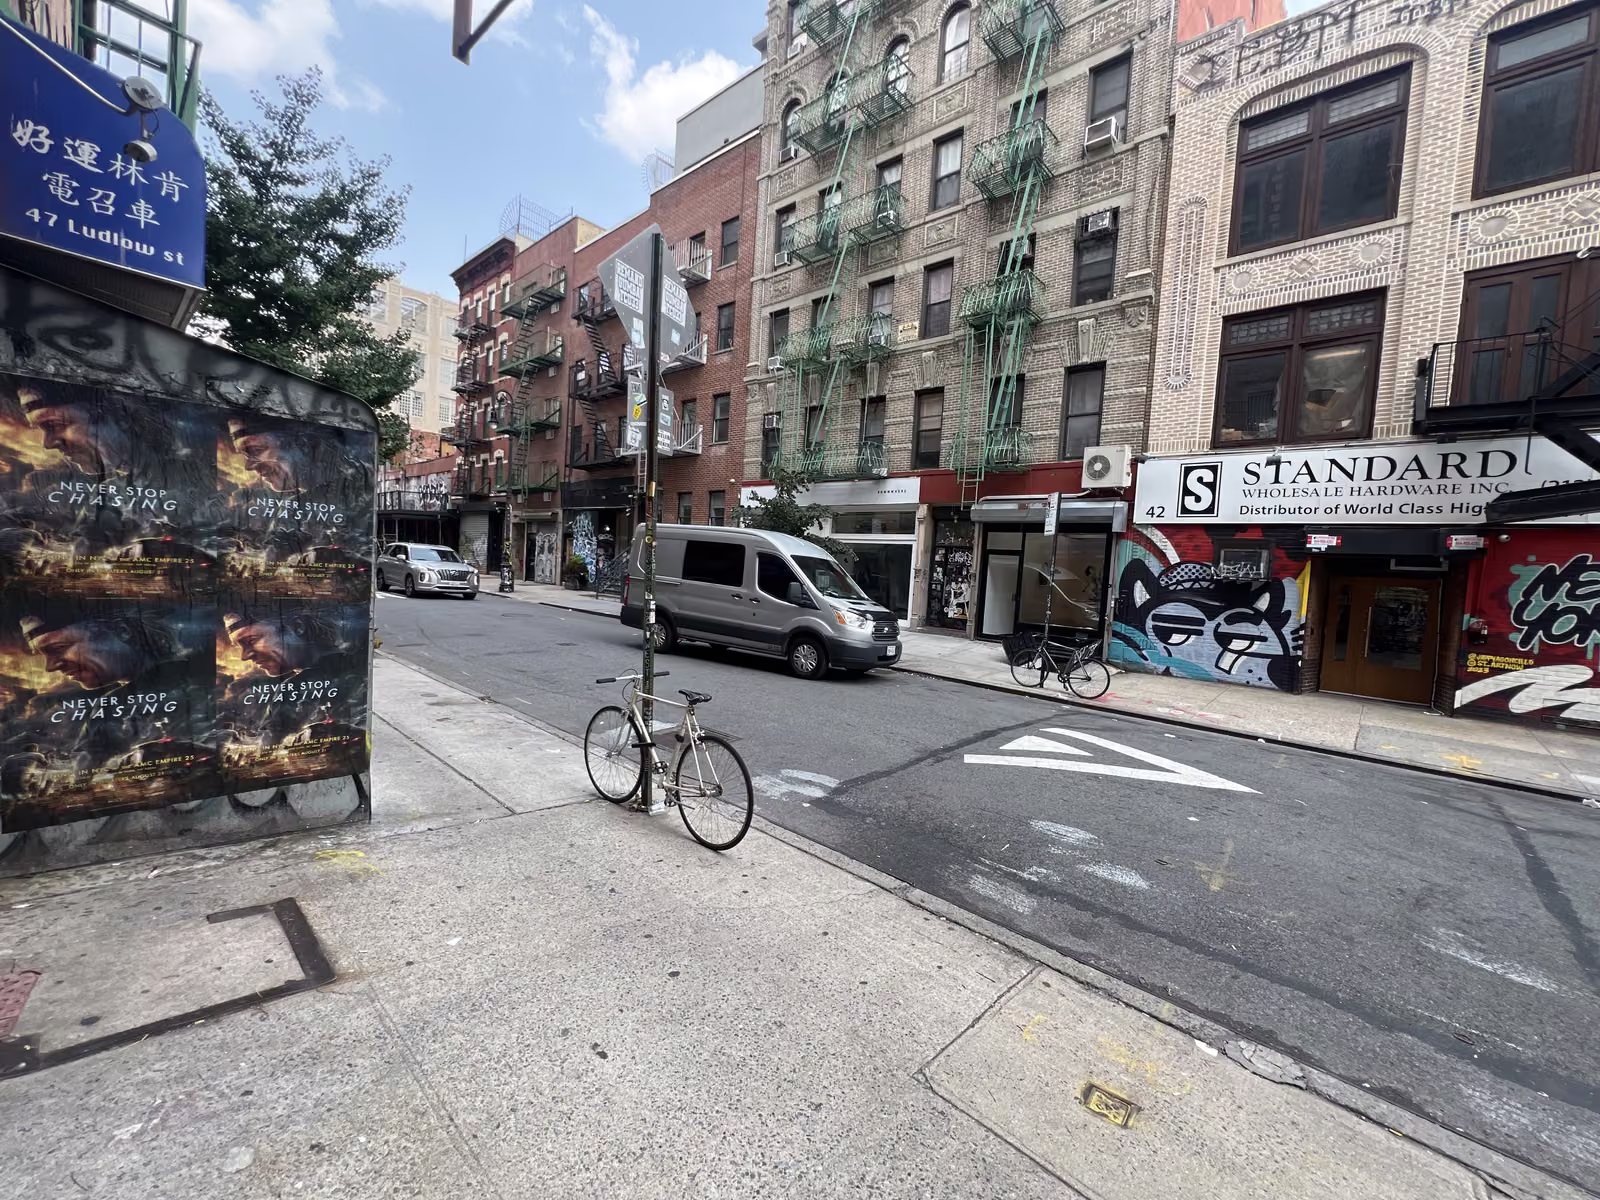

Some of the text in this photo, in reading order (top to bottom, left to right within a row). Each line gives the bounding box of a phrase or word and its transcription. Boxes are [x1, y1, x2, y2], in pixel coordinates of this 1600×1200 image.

[12, 119, 189, 203] 好運林肯
[42, 171, 160, 230] 電召車
[25, 208, 185, 266] 47 Ludlow st
[1243, 449, 1518, 486] STANDARD
[60, 481, 167, 498] NEVER STOP
[1184, 468, 1215, 512] S
[1242, 485, 1345, 499] WHOLESALE
[1349, 482, 1463, 498] HARDWARE
[48, 491, 178, 511] CHASING
[256, 497, 336, 513] NEVER STOP
[1239, 500, 1490, 518] Distributor of World Class Hig
[247, 505, 345, 524] CHASING
[1146, 505, 1166, 518] 42
[243, 687, 339, 706] CHASING
[252, 680, 331, 694] NEVER STOP
[62, 692, 167, 711] NEVER STOP
[50, 700, 178, 724] CHASING
[155, 757, 182, 765] EMPIRE
